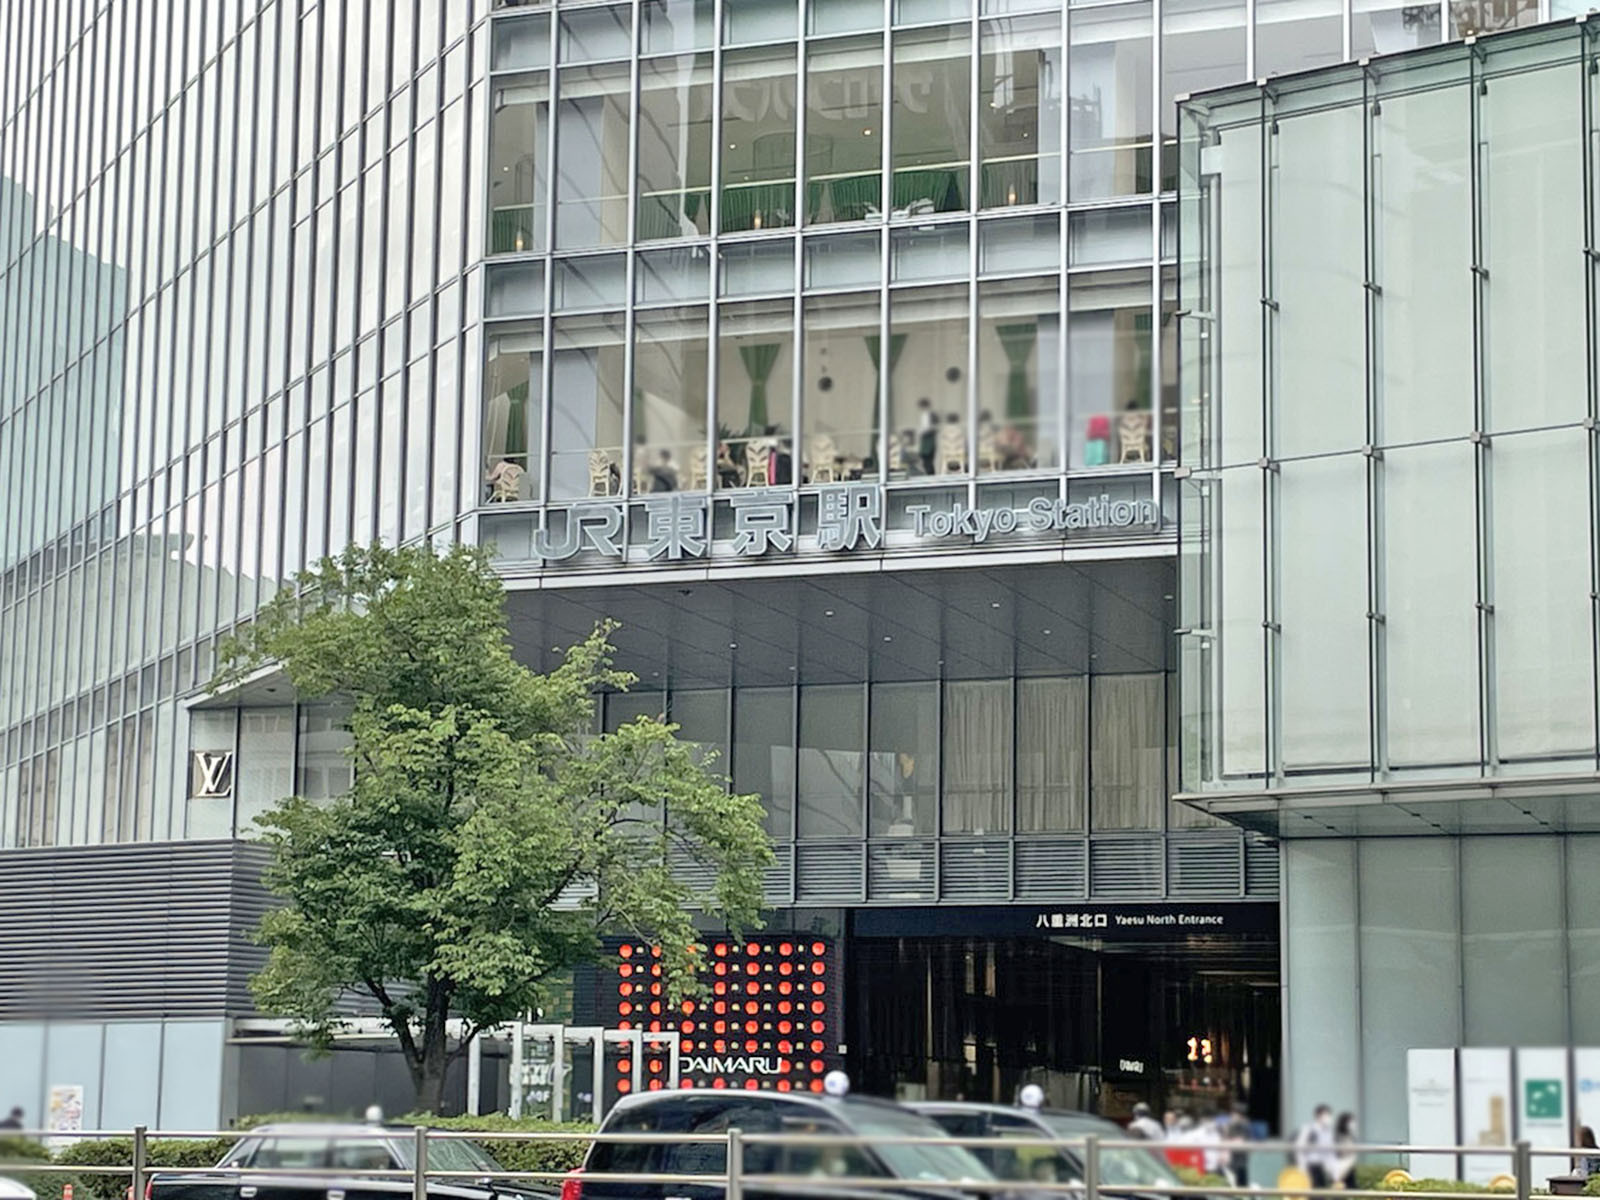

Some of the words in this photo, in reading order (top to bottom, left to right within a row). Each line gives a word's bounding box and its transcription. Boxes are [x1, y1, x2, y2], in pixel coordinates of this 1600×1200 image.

[906, 503, 1016, 542] Tokyo
[1028, 494, 1160, 533] Station
[1036, 913, 1108, 928] 八重洲北口
[1115, 915, 1145, 925] Yaesu
[1146, 914, 1177, 925] North
[1178, 914, 1224, 925] Entrance
[680, 1056, 782, 1074] DAIMARU
